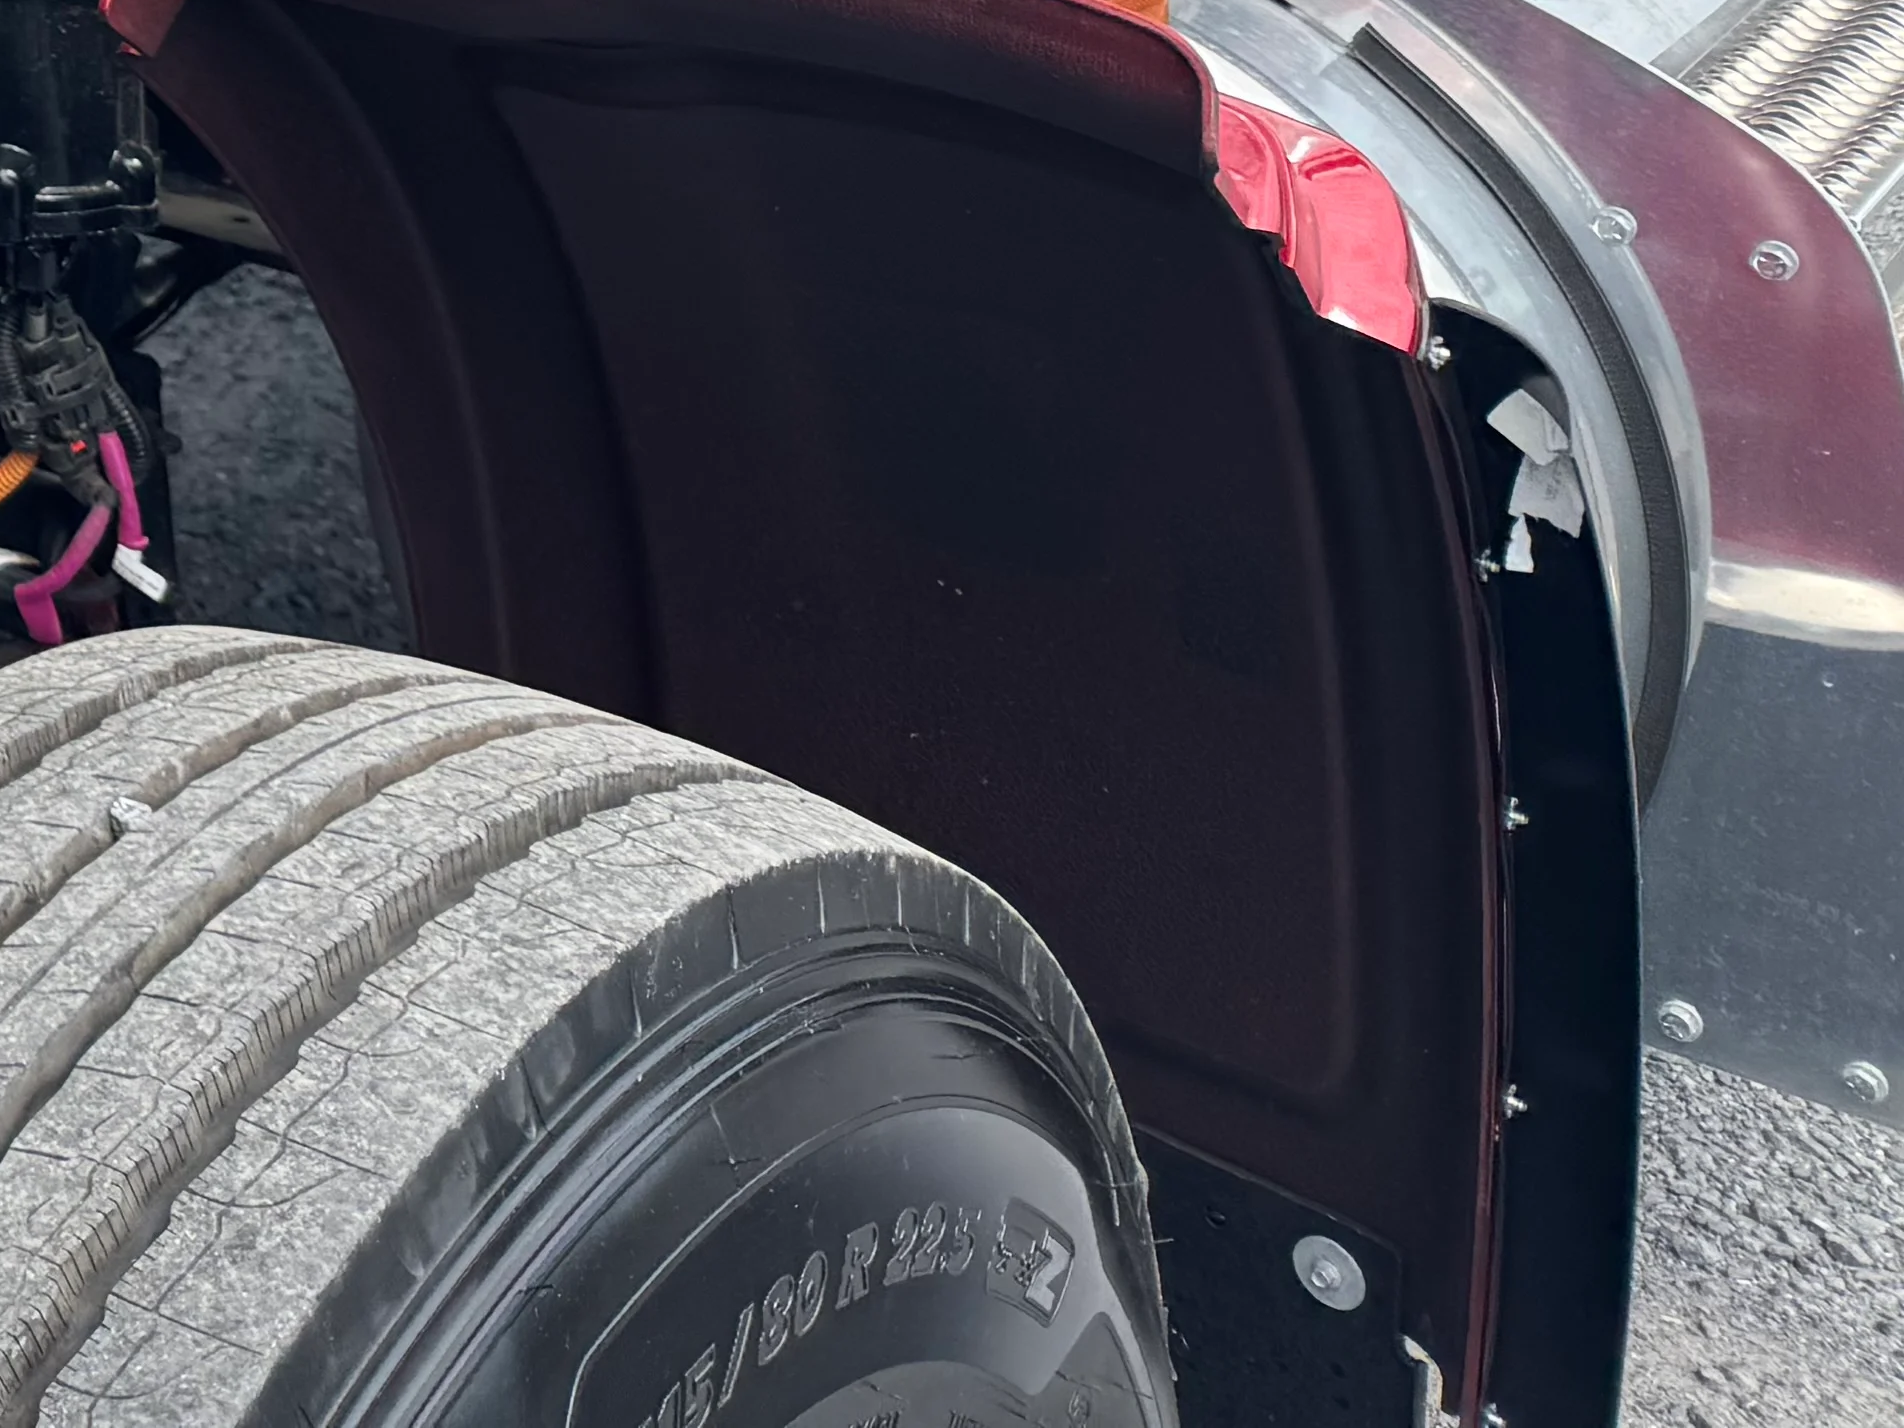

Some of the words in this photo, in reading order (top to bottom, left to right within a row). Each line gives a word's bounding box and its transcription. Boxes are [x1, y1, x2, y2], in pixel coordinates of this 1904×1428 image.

[637, 1250, 829, 1428] 15/80
[835, 1220, 880, 1311] R
[883, 1200, 983, 1287] 22.5
